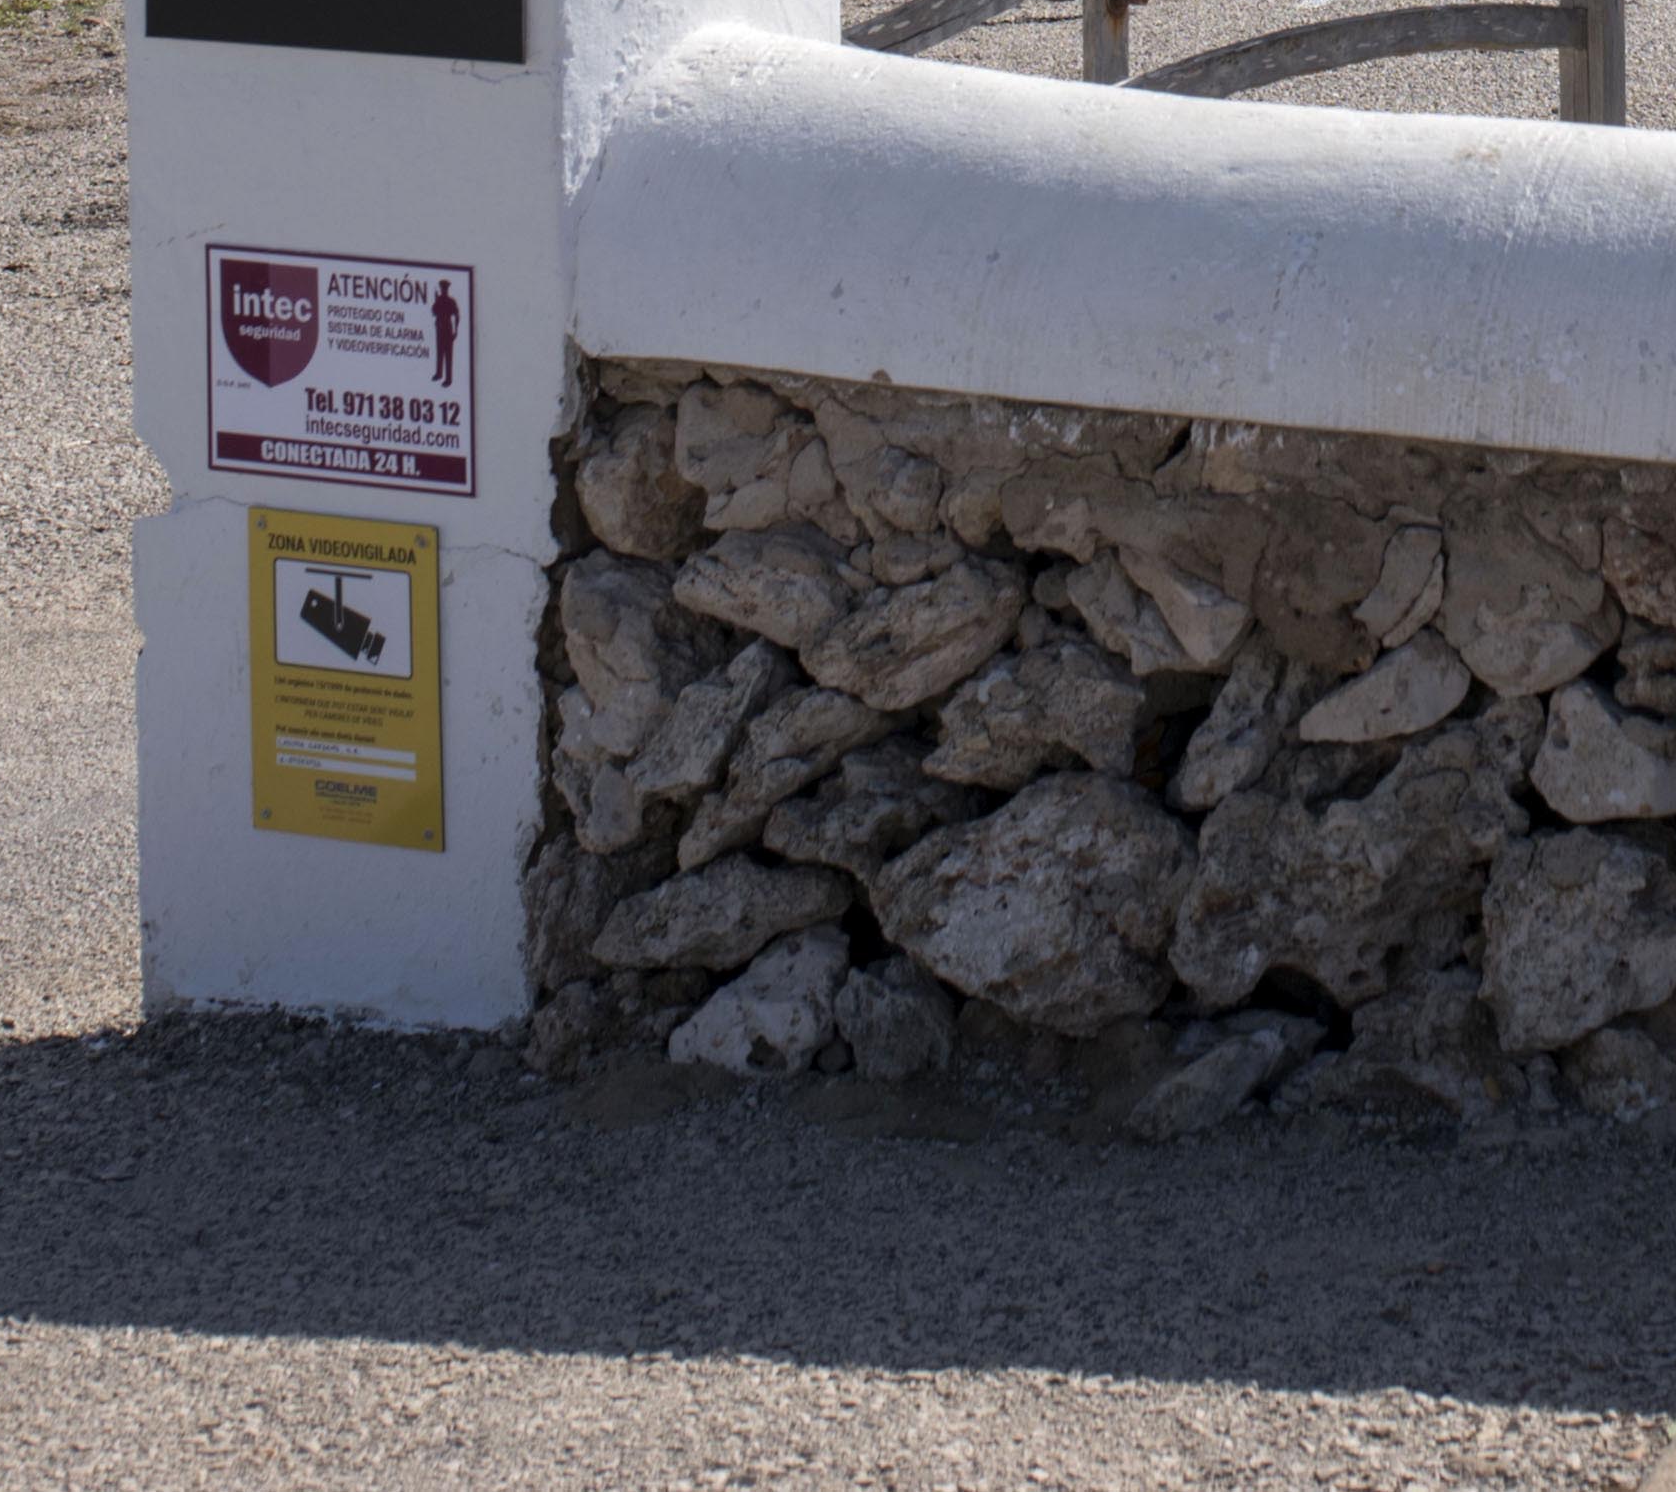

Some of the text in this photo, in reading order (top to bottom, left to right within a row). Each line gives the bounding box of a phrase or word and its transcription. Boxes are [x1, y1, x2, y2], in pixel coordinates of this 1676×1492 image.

[233, 283, 313, 323] intec
[327, 273, 428, 305] ATENCIÓN
[327, 305, 405, 324] PROTEGIDO CON
[239, 323, 301, 342] seguridad
[327, 321, 425, 342] SISTEMA DE ALARMA
[327, 338, 430, 359] Y VIDEOVERIFICACIÓN
[305, 387, 460, 426] Tel. 971 38 03 12
[305, 414, 460, 450] intecseguridad.com
[261, 439, 421, 476] CONECTADA 24 H.
[268, 533, 417, 565] ZONA VIDEOVIGILADA
